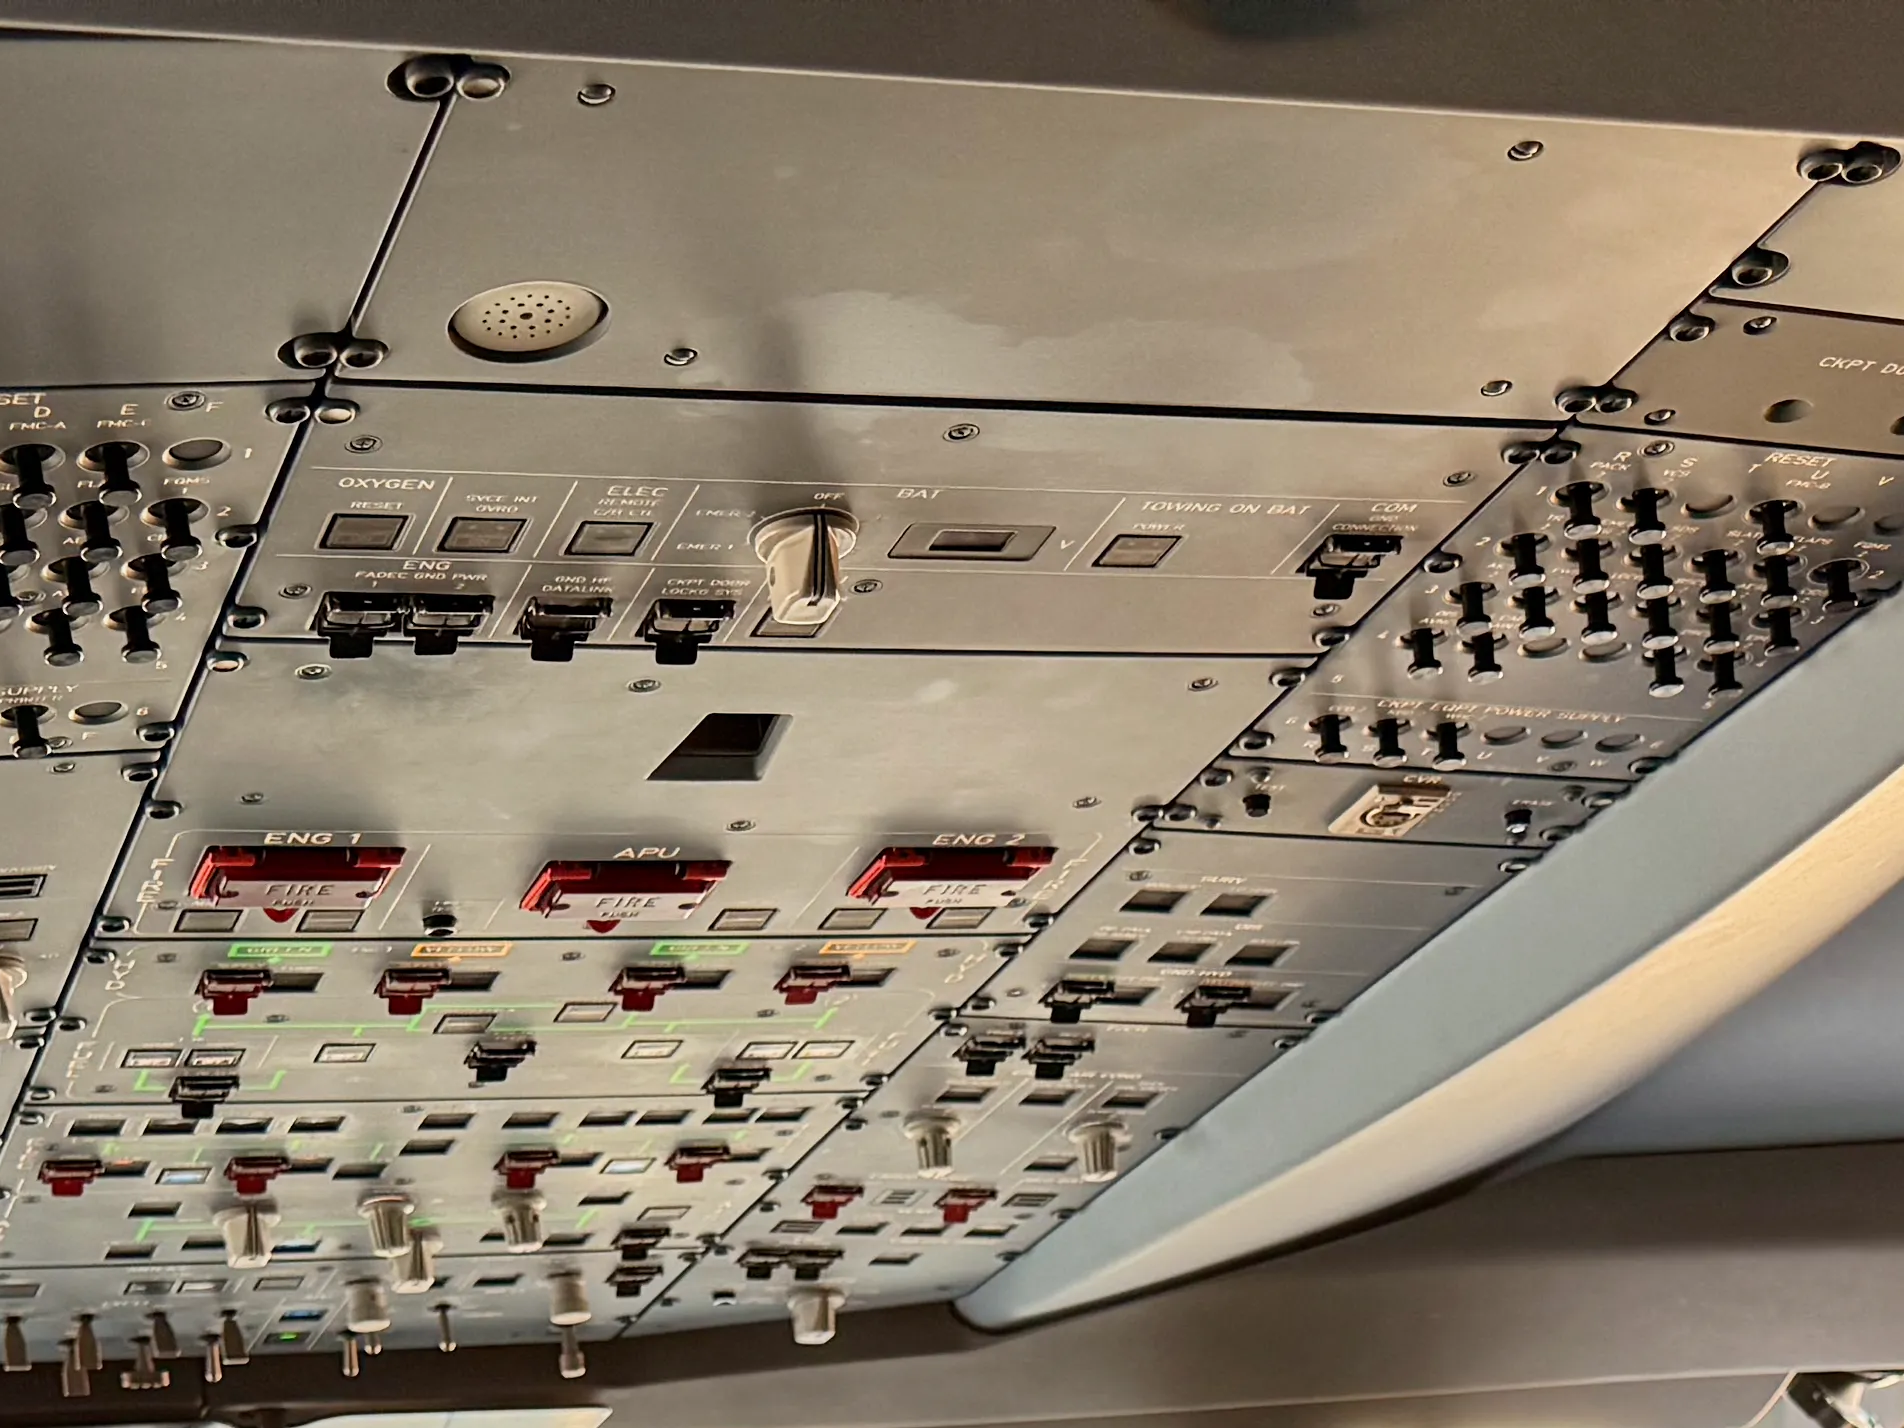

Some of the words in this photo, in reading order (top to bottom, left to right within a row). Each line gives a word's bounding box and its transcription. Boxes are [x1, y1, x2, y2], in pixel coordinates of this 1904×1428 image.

[1818, 355, 1878, 372] CKPT
[33, 405, 52, 419] D
[119, 403, 139, 416] E
[204, 401, 225, 413] F
[8, 420, 68, 432] FMC-A
[1763, 451, 1838, 469] RESET
[1612, 451, 1633, 462] R
[1679, 457, 1699, 468] S
[1810, 469, 1831, 481] U
[1877, 475, 1895, 487] V
[337, 477, 436, 490] OXYGEN
[606, 485, 670, 498] ELEC
[813, 491, 846, 501] OFF
[896, 488, 943, 500] BAT
[350, 500, 406, 511] RESET
[1140, 501, 1223, 515] TOWING
[1227, 503, 1262, 516] ON
[1266, 504, 1313, 517] BAT
[1370, 502, 1419, 514] COM
[402, 559, 452, 571] ENG
[354, 570, 409, 580] FADEC
[413, 571, 448, 581] GND
[451, 571, 489, 581] PWR
[262, 832, 335, 845] ENG
[346, 832, 362, 845] 1
[932, 833, 997, 846] ENG
[1005, 833, 1026, 845] 2
[612, 846, 681, 859] APU
[264, 883, 335, 897] FIRE
[921, 884, 989, 896] FIRE
[594, 895, 660, 909] FIRE
